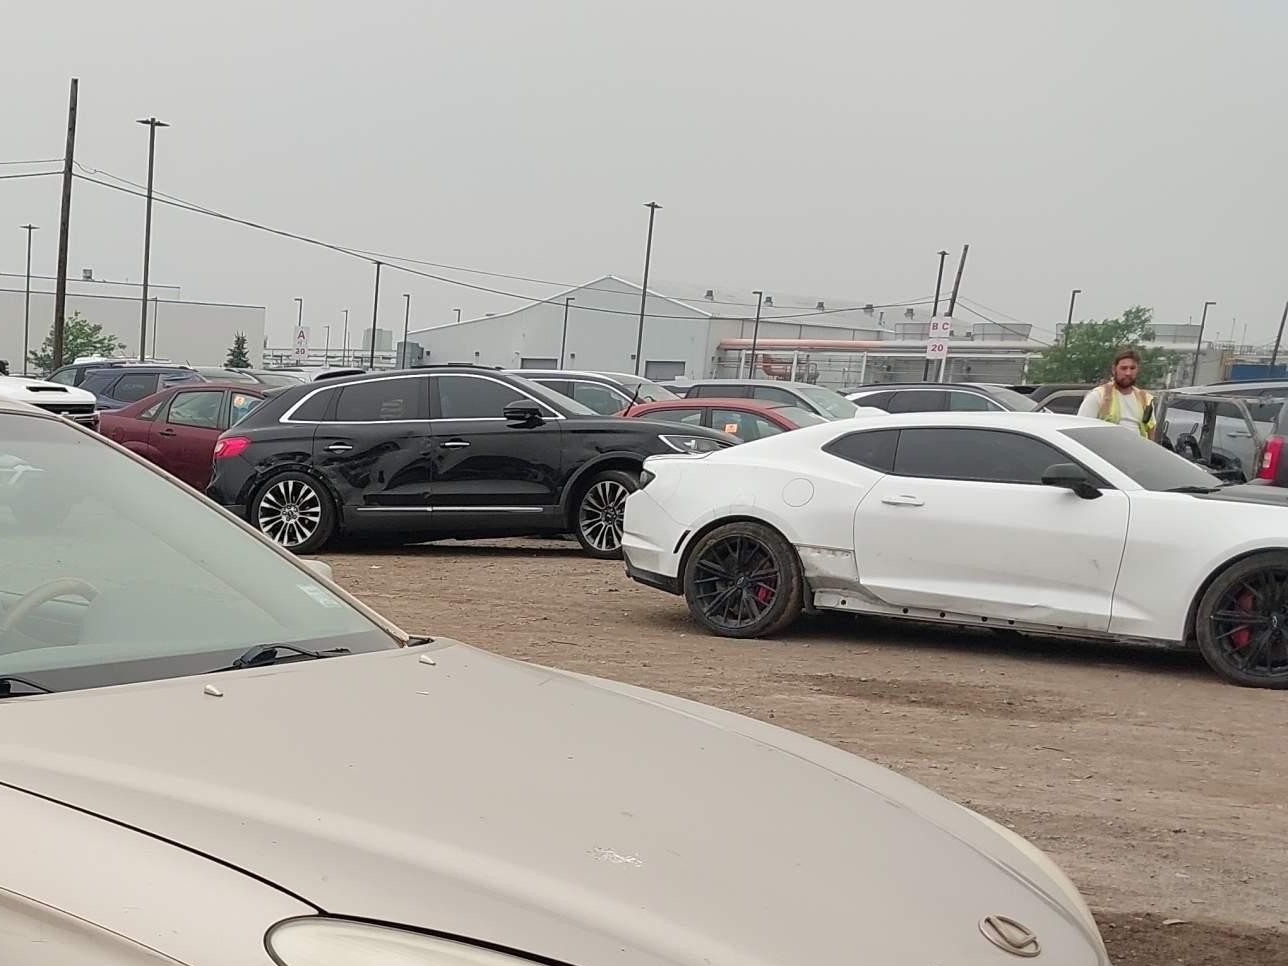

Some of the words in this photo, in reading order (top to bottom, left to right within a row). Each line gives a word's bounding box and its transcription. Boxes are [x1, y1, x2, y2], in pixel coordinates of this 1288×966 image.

[942, 322, 950, 330] C
[297, 330, 305, 339] A
[931, 344, 944, 352] 20
